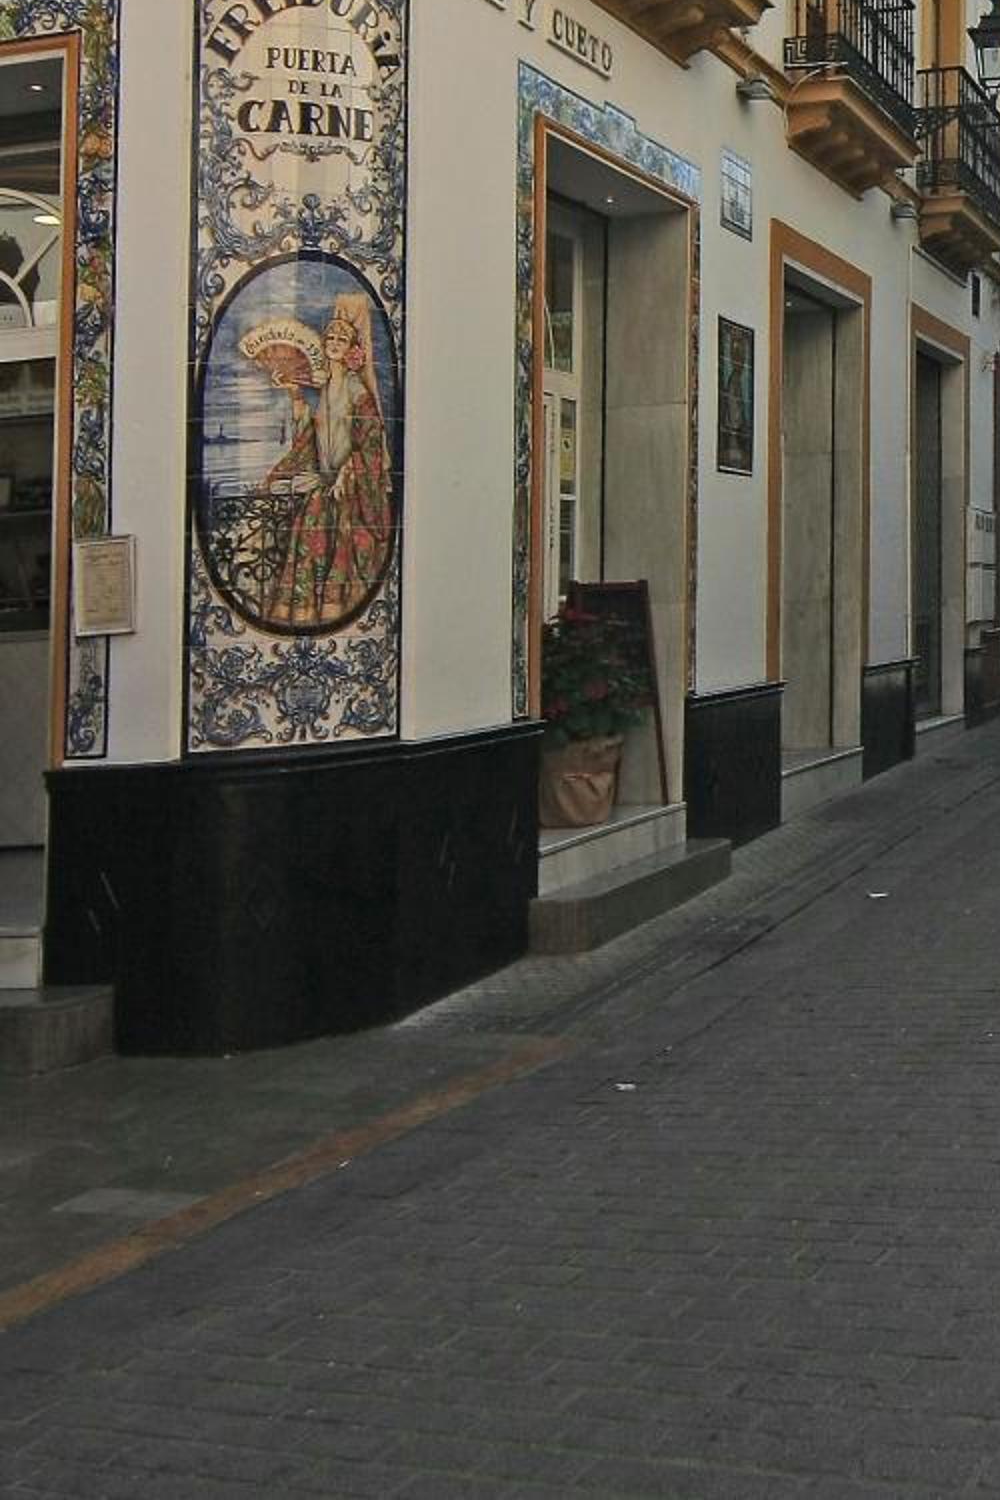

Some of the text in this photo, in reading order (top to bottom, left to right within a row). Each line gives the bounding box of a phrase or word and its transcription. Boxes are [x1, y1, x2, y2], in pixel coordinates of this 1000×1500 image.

[552, 10, 614, 73] CUETO
[266, 48, 357, 77] PUERTA
[289, 80, 344, 99] DE LA
[237, 99, 375, 143] CARNE
